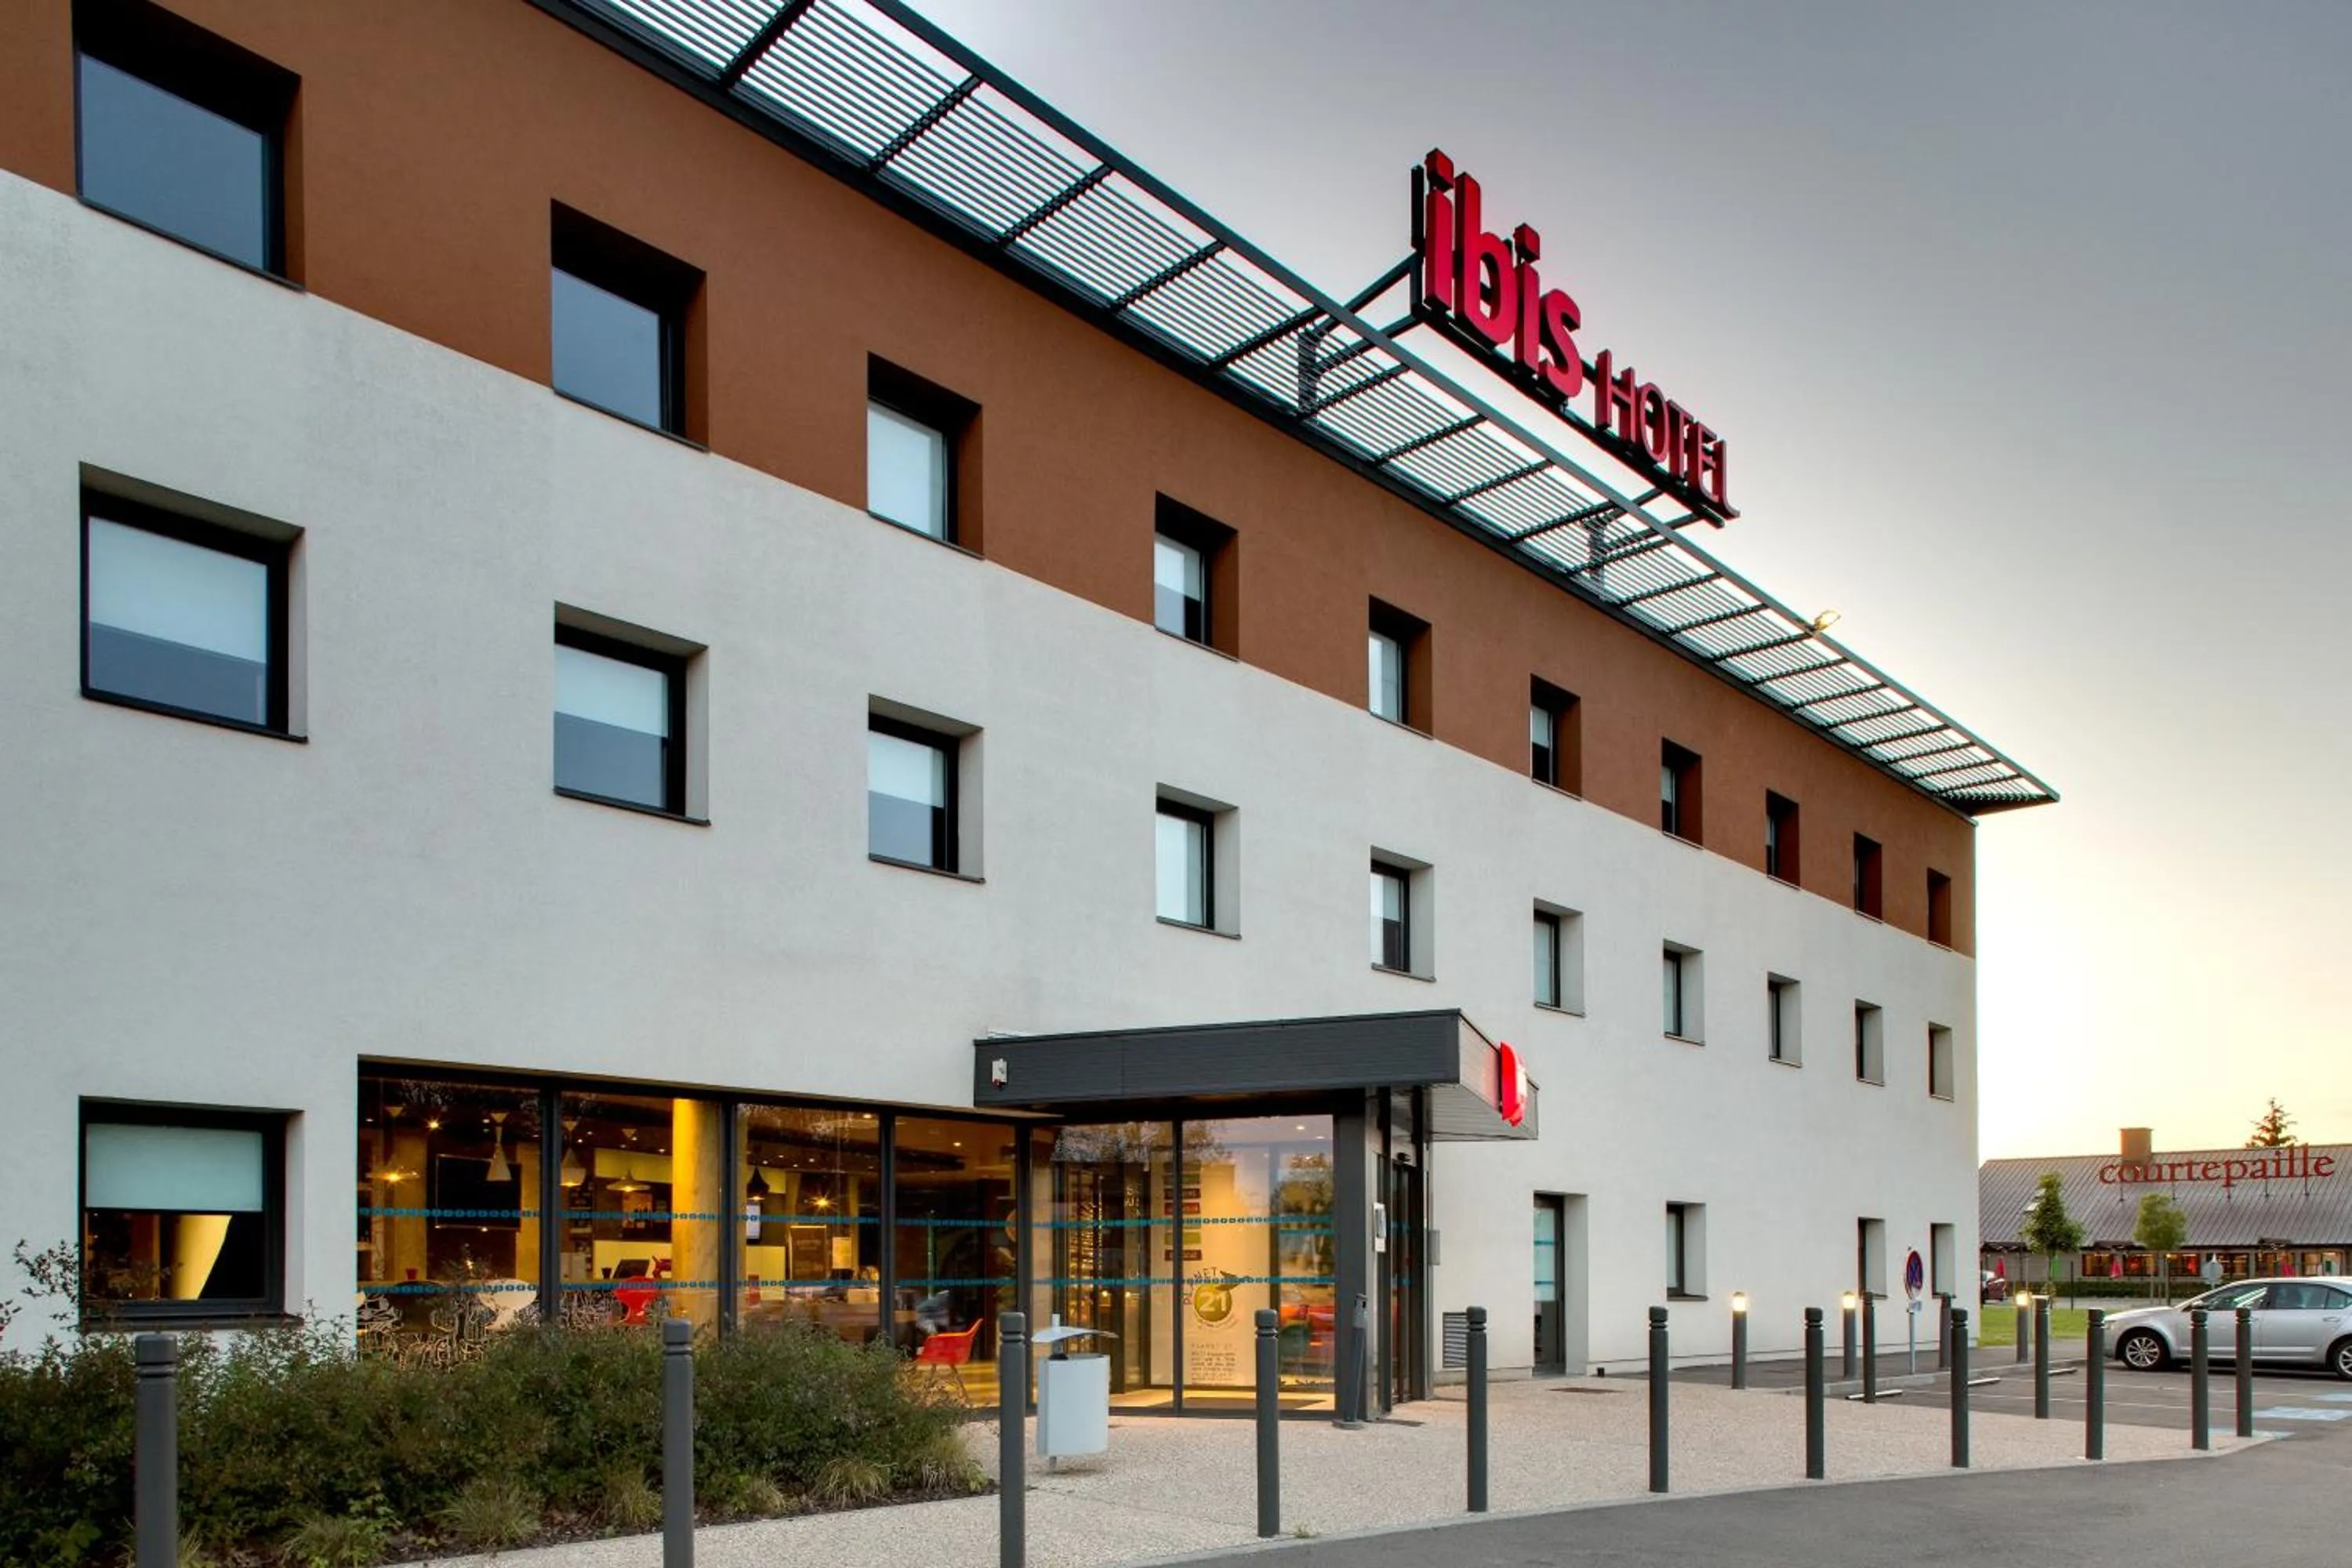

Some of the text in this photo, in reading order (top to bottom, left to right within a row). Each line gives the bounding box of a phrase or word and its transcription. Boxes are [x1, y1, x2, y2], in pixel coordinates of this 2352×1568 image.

[1424, 147, 1741, 519] ibis HOTEL
[2099, 1143, 2336, 1187] courtepaille
[1199, 1292, 1228, 1312] 21
